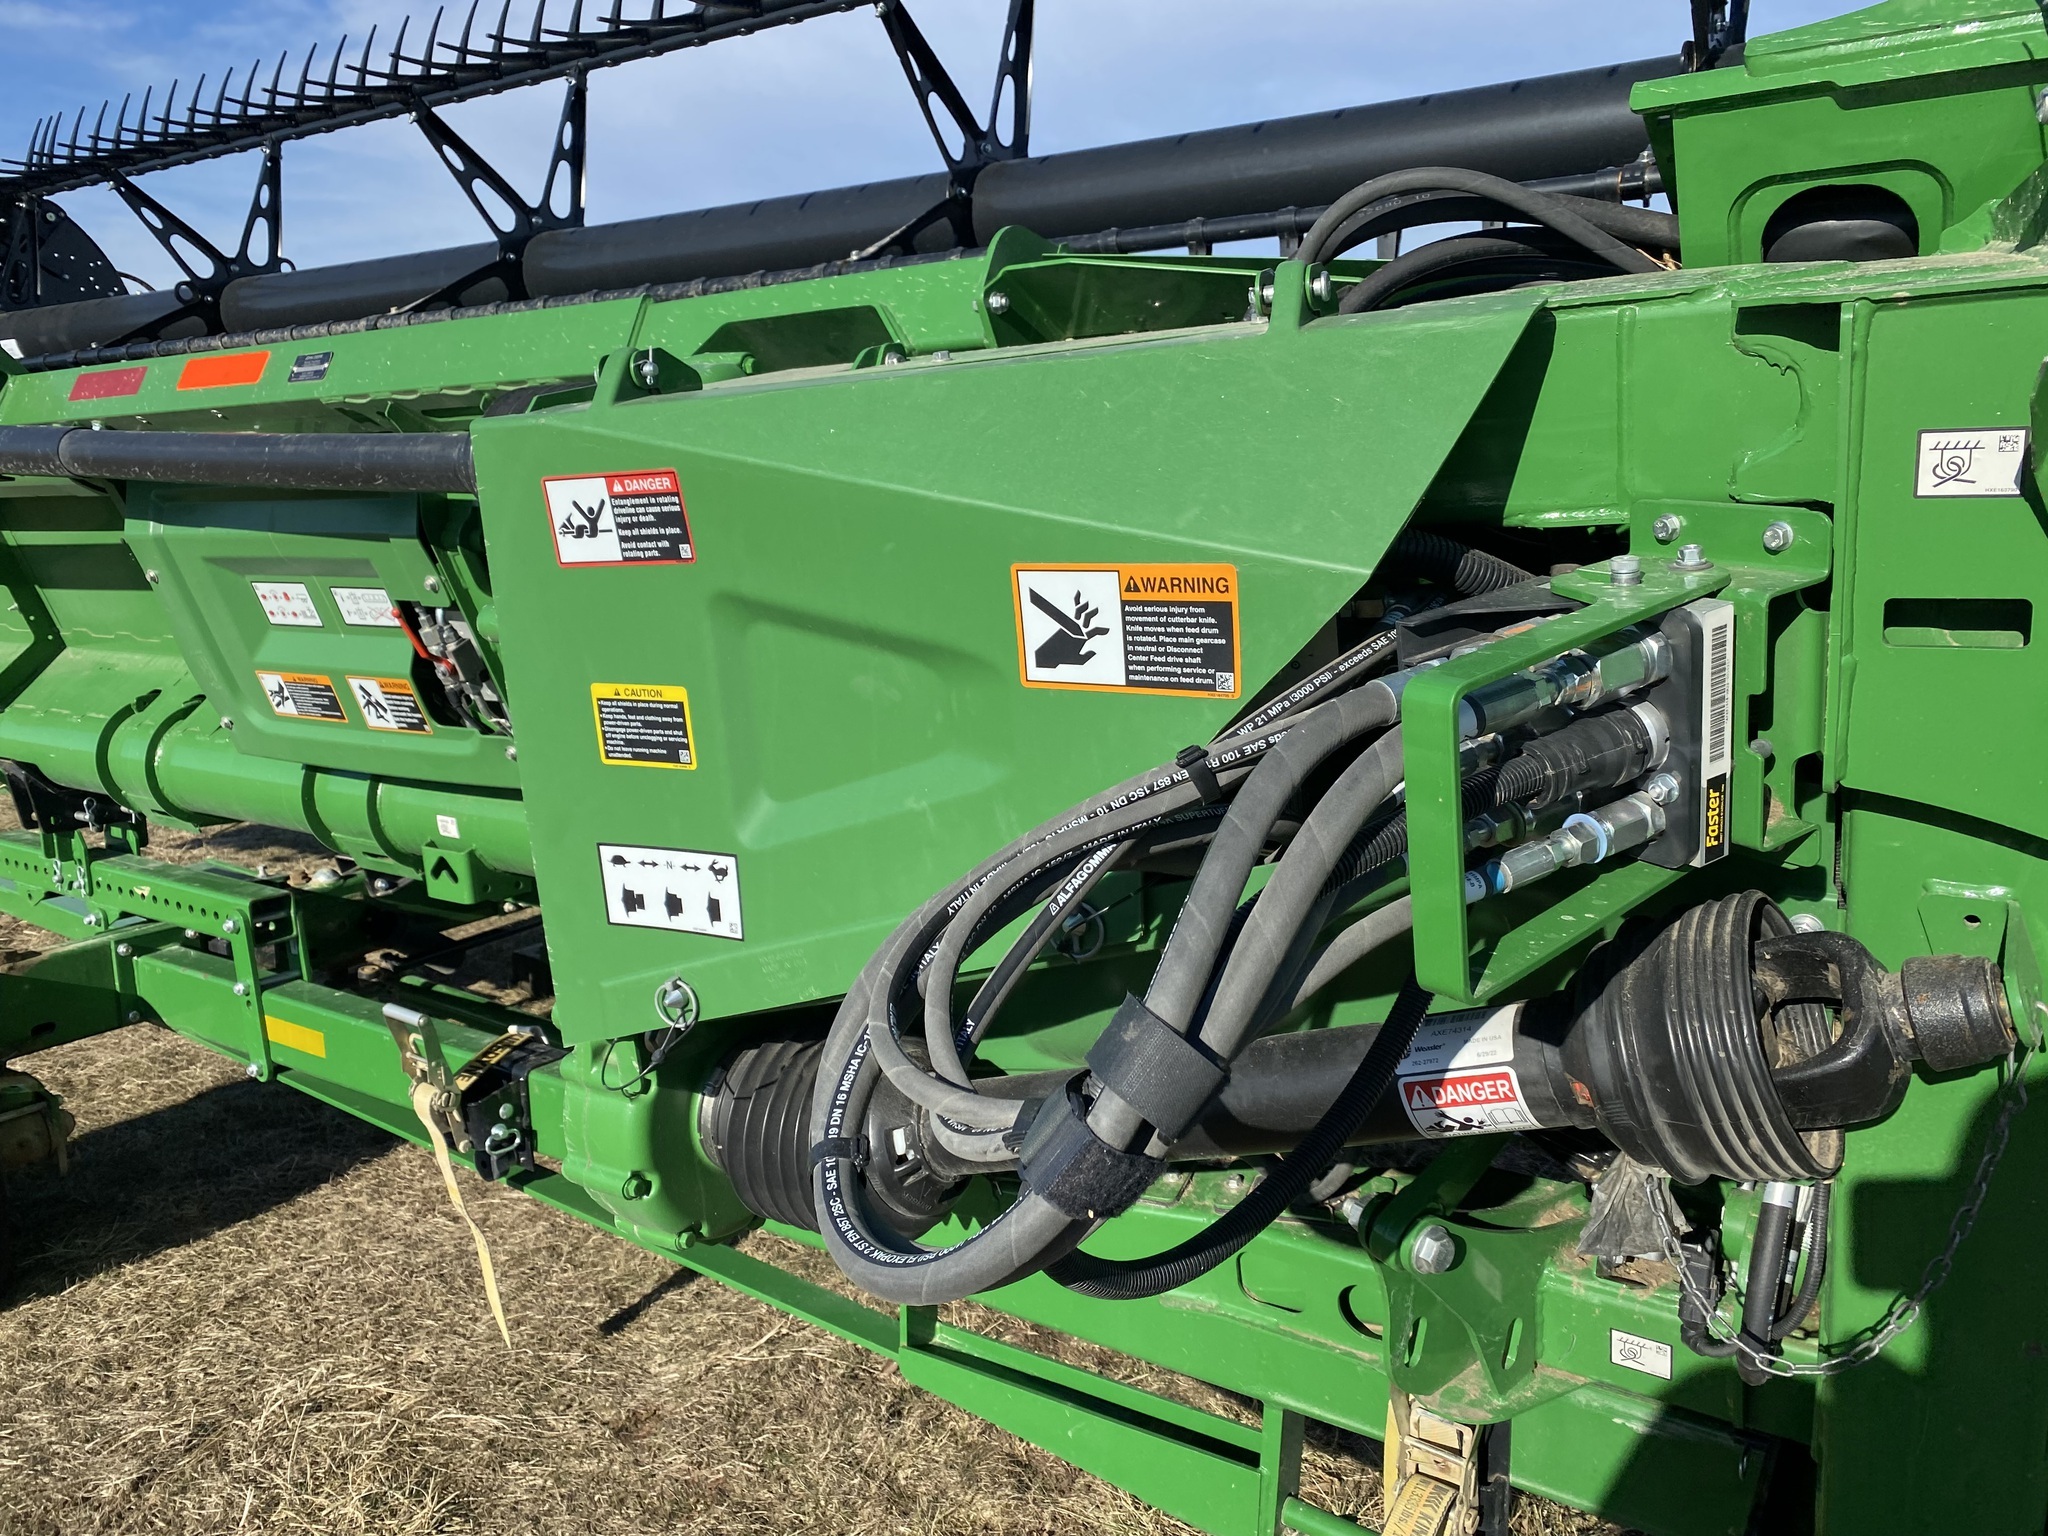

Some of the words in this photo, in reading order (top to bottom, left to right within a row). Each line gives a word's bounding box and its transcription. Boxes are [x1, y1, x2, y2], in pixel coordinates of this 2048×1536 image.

[624, 477, 671, 490] DANGER
[611, 496, 648, 506] Entanglement
[656, 495, 679, 504] rotating
[613, 506, 635, 514] driveline
[614, 515, 631, 524] injury
[617, 528, 631, 536] Keep
[664, 526, 682, 534] place.
[622, 550, 644, 558] rotating
[1140, 576, 1228, 593] WARNING
[1169, 606, 1188, 614] injury
[1195, 637, 1226, 646] gearcase
[1166, 645, 1203, 654] Disconnect
[1146, 664, 1181, 674] performing
[1128, 673, 1168, 682] maintenance
[384, 681, 410, 690] WARNING
[1237, 722, 1254, 736] WP
[1255, 715, 1268, 726] 21
[1268, 700, 1290, 717] MPa
[1339, 647, 1373, 672] exceeds
[1371, 637, 1389, 650] SAE
[623, 688, 662, 698] CAUTION
[1244, 739, 1266, 755] SAE
[1222, 750, 1241, 764] 100
[1174, 770, 1189, 783] EN
[1153, 778, 1171, 791] 857
[1129, 786, 1150, 801] 1SC
[1111, 796, 1128, 809] DN
[1096, 806, 1109, 816] 10
[1706, 789, 1719, 847] Faster
[947, 892, 970, 916] ITALY
[840, 1059, 861, 1091] MSHA
[836, 1093, 847, 1105] 16
[1431, 1080, 1514, 1105] DANGER
[831, 1108, 842, 1125] DN
[826, 1169, 838, 1190] SAE
[830, 1197, 844, 1216] 2SC
[836, 1218, 851, 1232] 857
[845, 1230, 860, 1242] EN
[854, 1240, 869, 1250] ST
